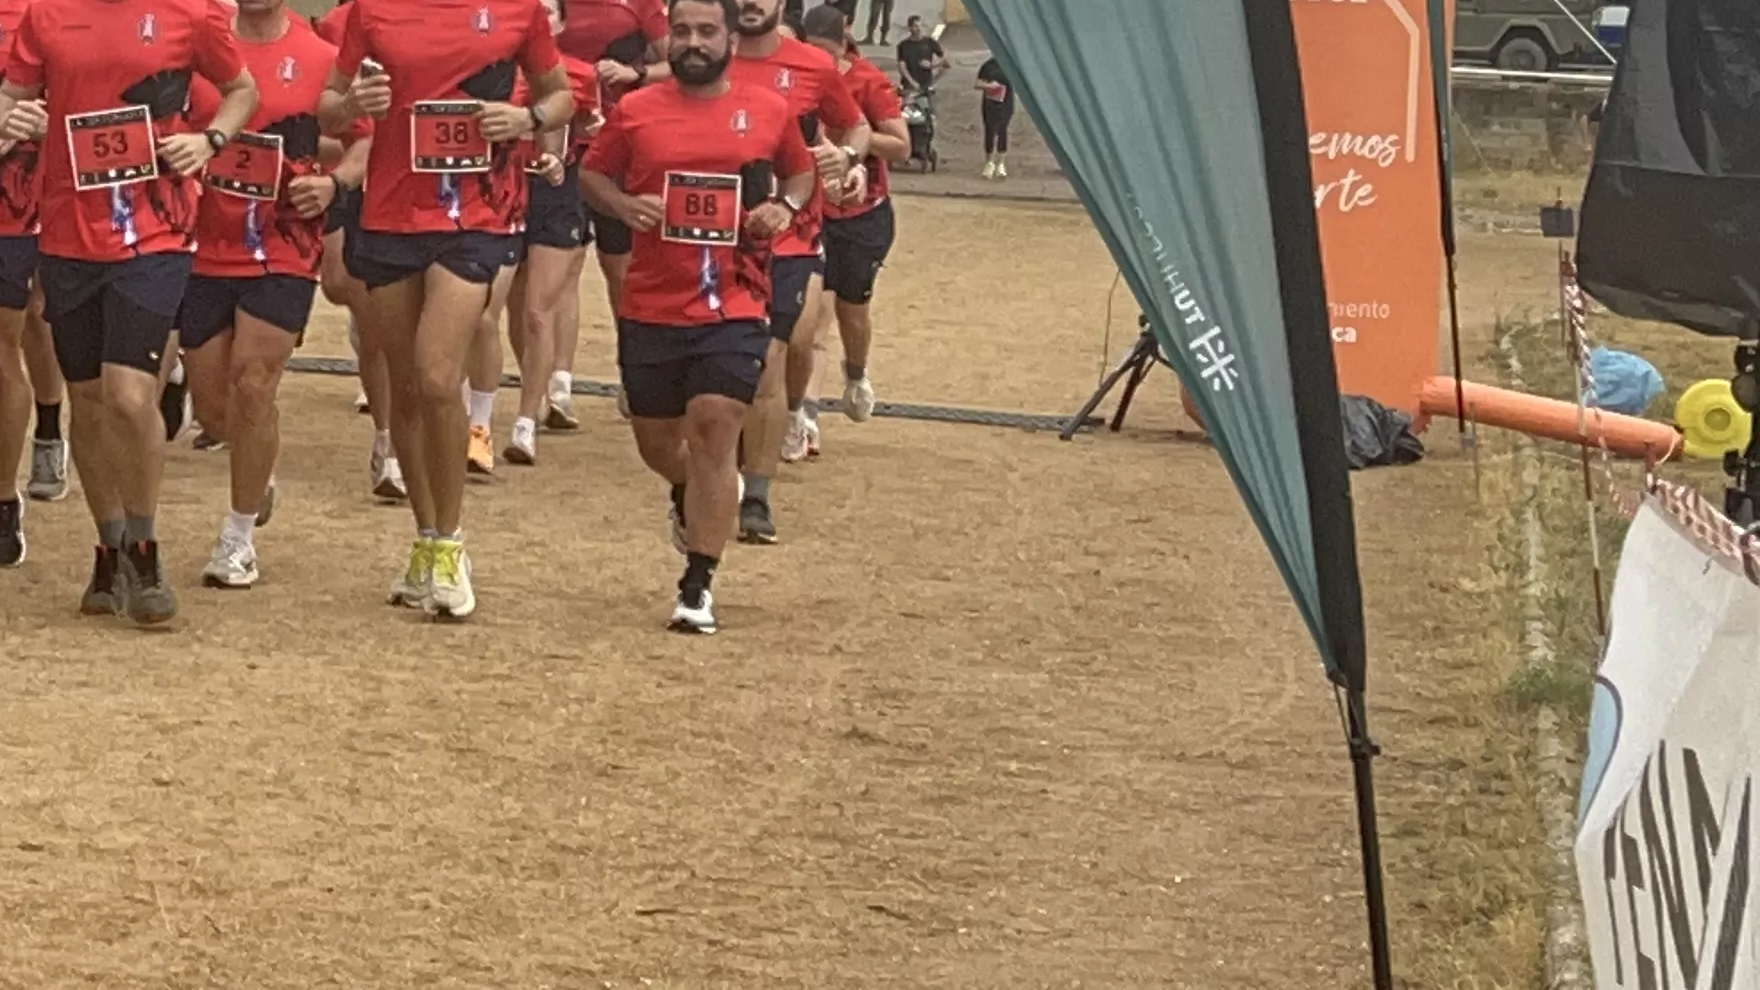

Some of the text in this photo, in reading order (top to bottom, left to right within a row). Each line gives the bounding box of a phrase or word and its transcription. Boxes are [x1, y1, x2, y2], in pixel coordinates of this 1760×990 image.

[93, 130, 128, 159] 53
[1308, 131, 1401, 168] emos
[1313, 167, 1379, 212] rte
[1331, 326, 1358, 344] ca
